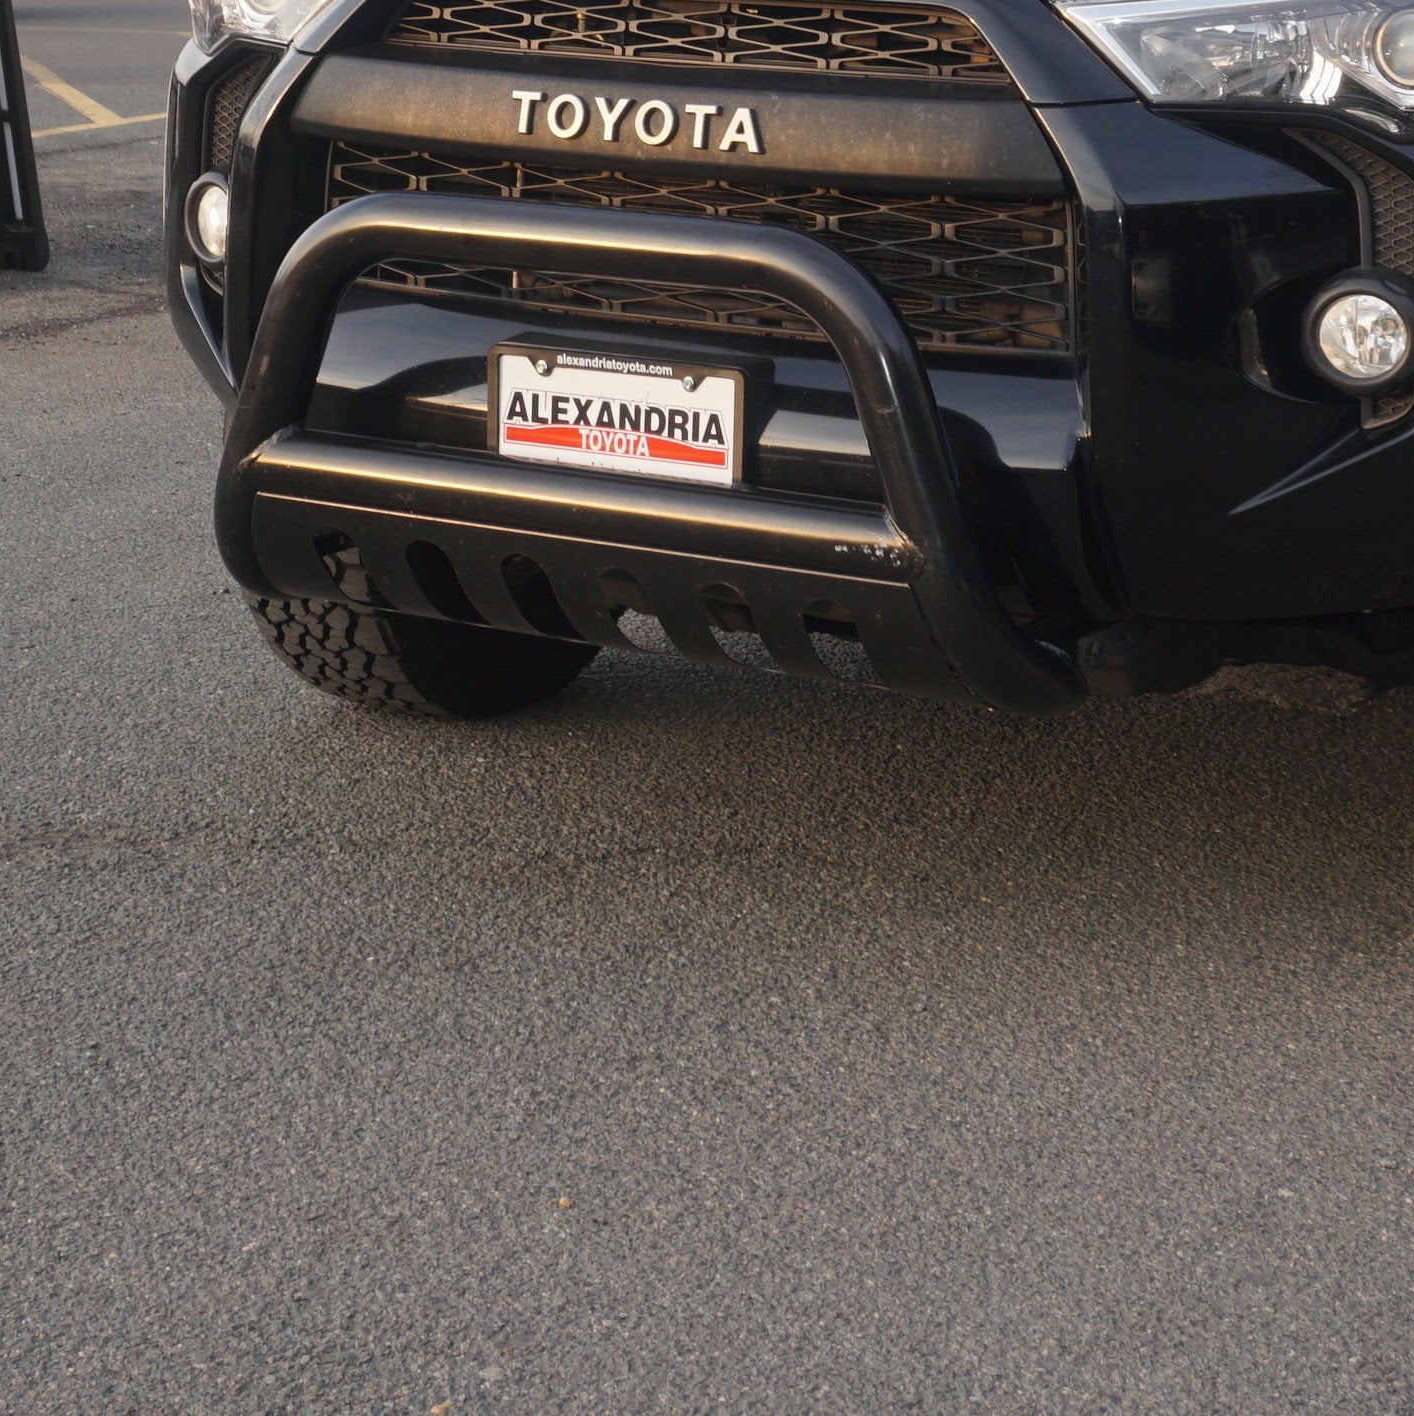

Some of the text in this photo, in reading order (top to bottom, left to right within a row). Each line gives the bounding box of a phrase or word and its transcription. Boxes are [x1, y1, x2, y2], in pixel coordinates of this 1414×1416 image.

[512, 90, 762, 154] TOYOTA
[556, 353, 674, 376] alexandriatoyota.com
[506, 390, 725, 445] ALEXANDRIA
[578, 428, 651, 457] TOYOTA
